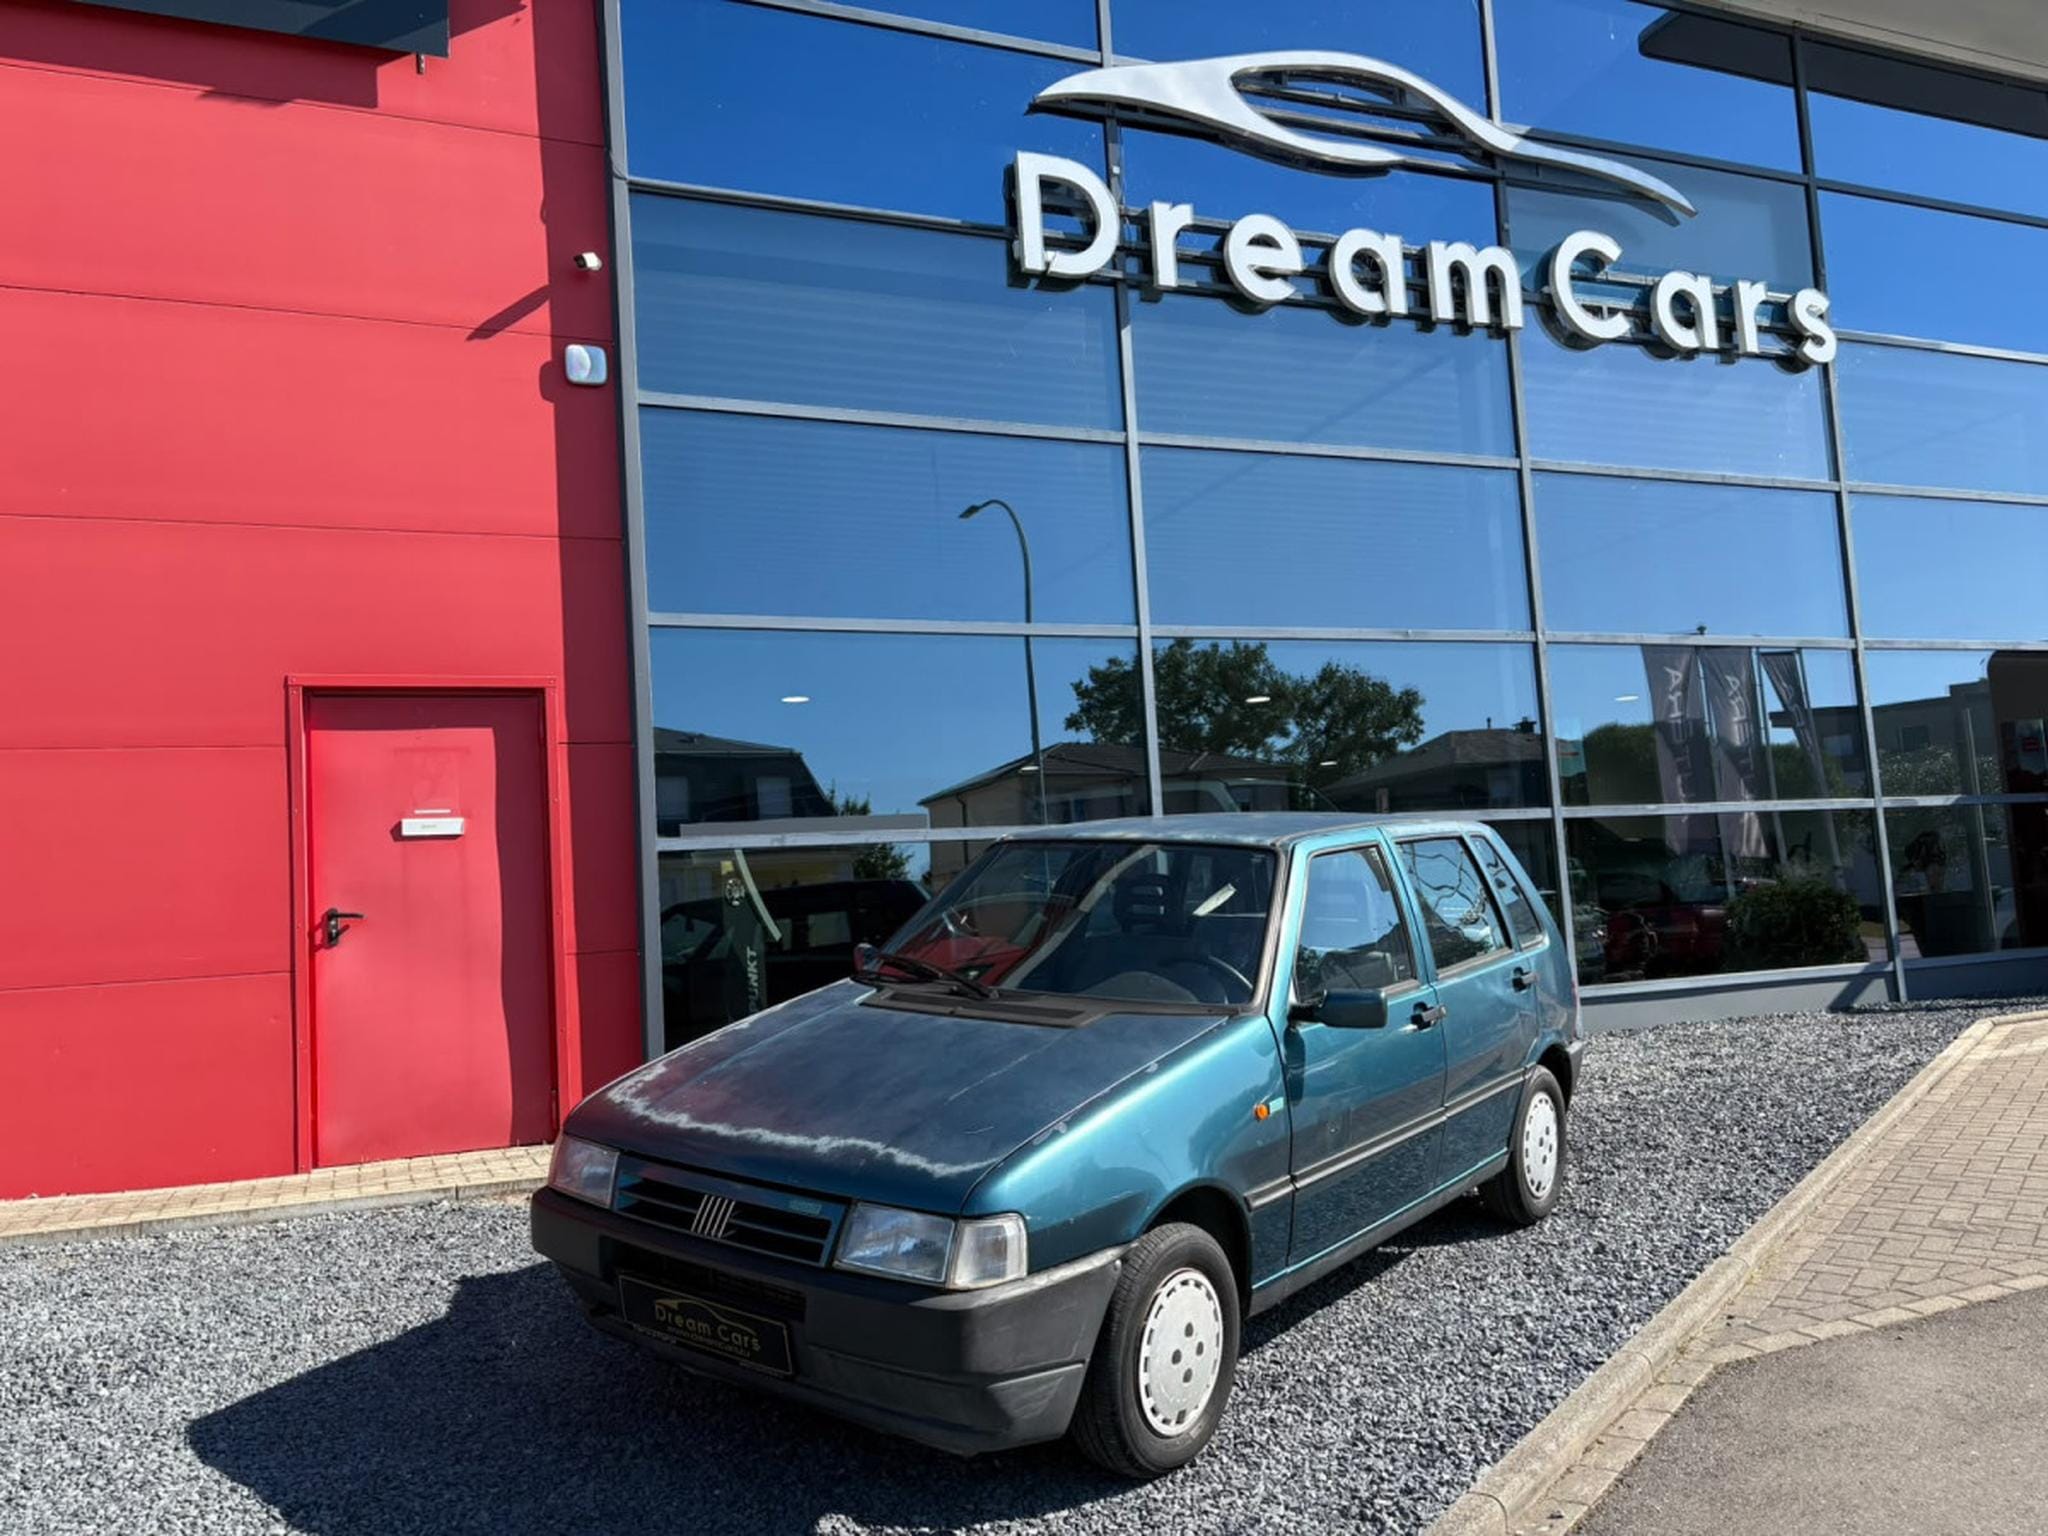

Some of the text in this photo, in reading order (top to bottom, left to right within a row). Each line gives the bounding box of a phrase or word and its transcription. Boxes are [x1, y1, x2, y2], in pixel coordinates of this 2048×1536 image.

[1013, 149, 1838, 364] Dream Cars
[655, 1305, 712, 1338] Dream
[717, 1325, 761, 1353] Cars
